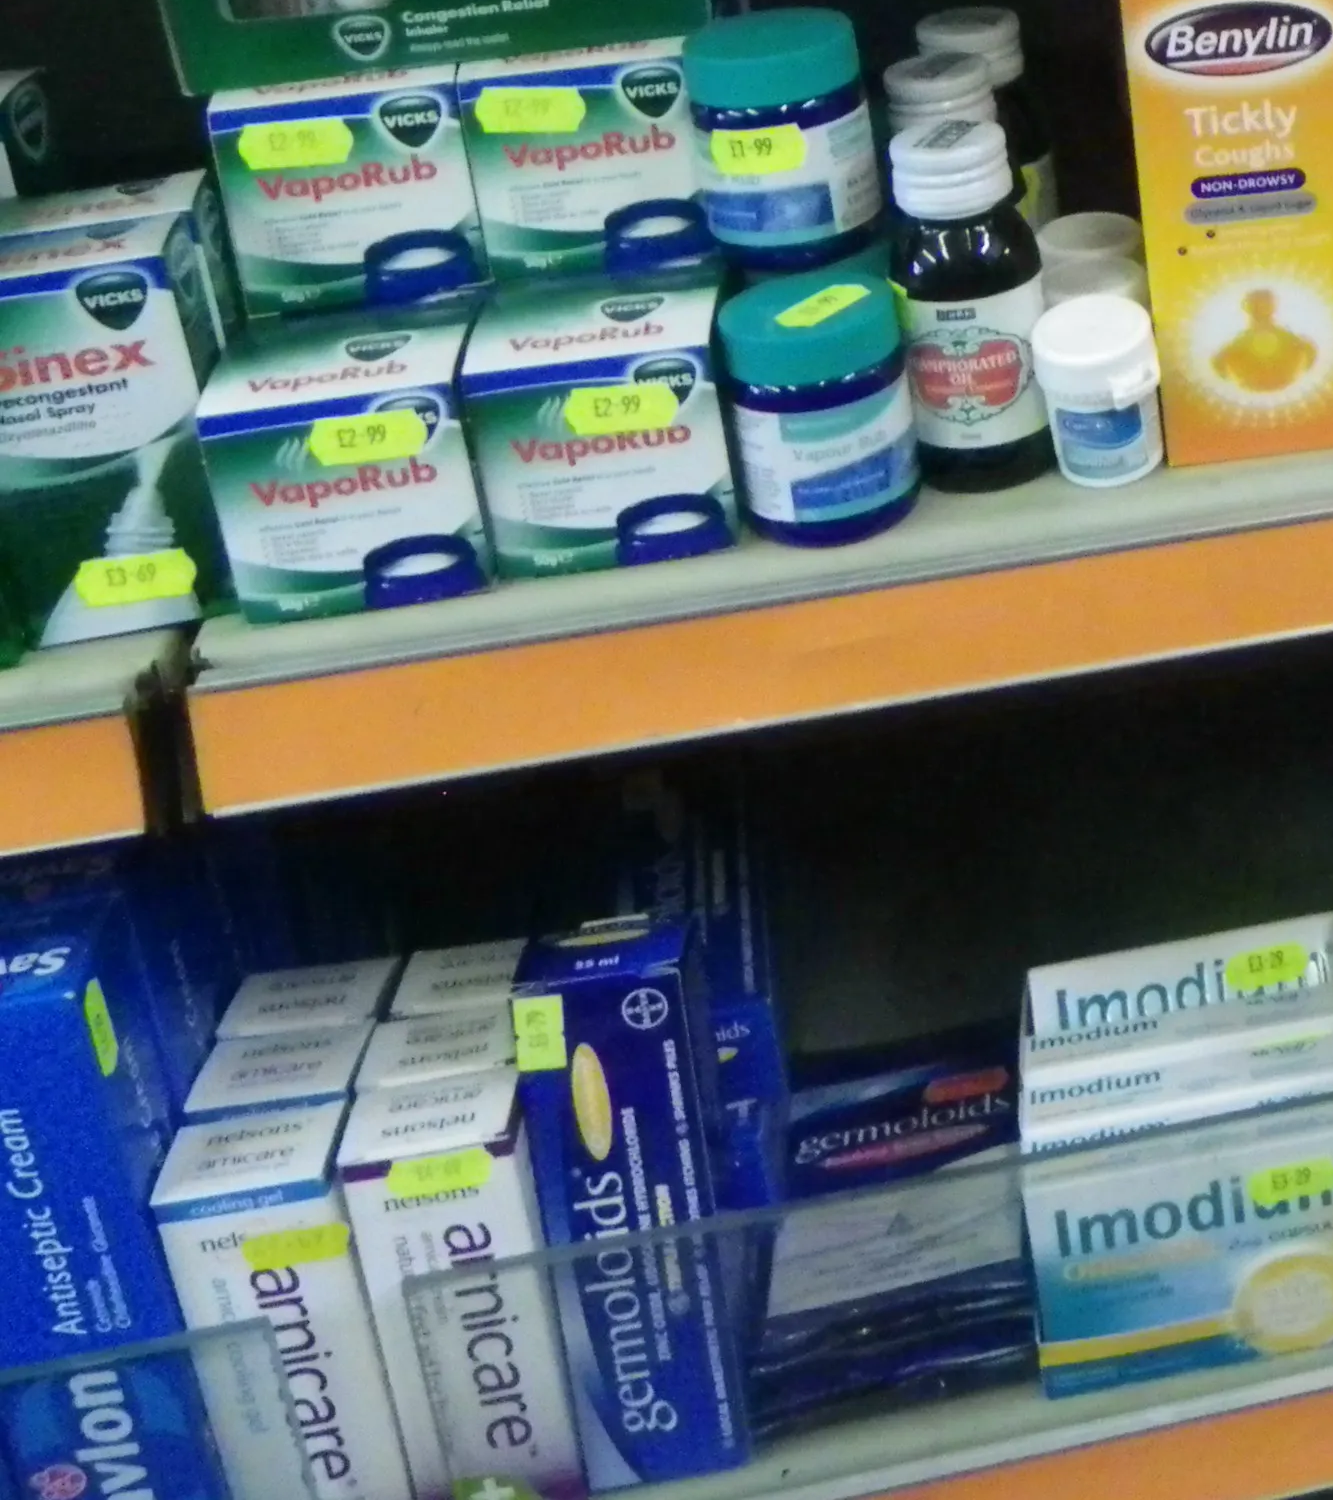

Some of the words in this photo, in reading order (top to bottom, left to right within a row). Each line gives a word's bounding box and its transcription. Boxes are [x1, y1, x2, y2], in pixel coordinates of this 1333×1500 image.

[403, 4, 499, 25] Congestion
[344, 31, 382, 45] VICKS
[1165, 18, 1313, 59] Benylin
[626, 81, 678, 99] VICKS
[385, 111, 437, 128] VICKS
[1184, 101, 1297, 140] Tickly
[503, 124, 676, 170] VapoRub
[1194, 140, 1294, 171] Coughs
[257, 154, 437, 201] VapoRub
[1200, 174, 1295, 193] NON-DROWSY
[84, 287, 145, 308] VICKS
[603, 299, 663, 314] VICKS
[509, 320, 666, 353] VapoRub
[247, 360, 407, 393] VapoRub
[46, 403, 96, 420] Spray
[249, 456, 438, 508] VapoRub
[1029, 1016, 1159, 1053] Imodium
[1030, 1068, 1161, 1106] Imodium
[204, 1118, 305, 1150] nelsons
[795, 1092, 1011, 1166] germoloids
[0, 1108, 45, 1202] Cream
[196, 1143, 296, 1172] arnicare
[51, 1205, 88, 1337] Antiseptic
[442, 1221, 533, 1451] arnicare
[248, 1264, 352, 1484] arnicare
